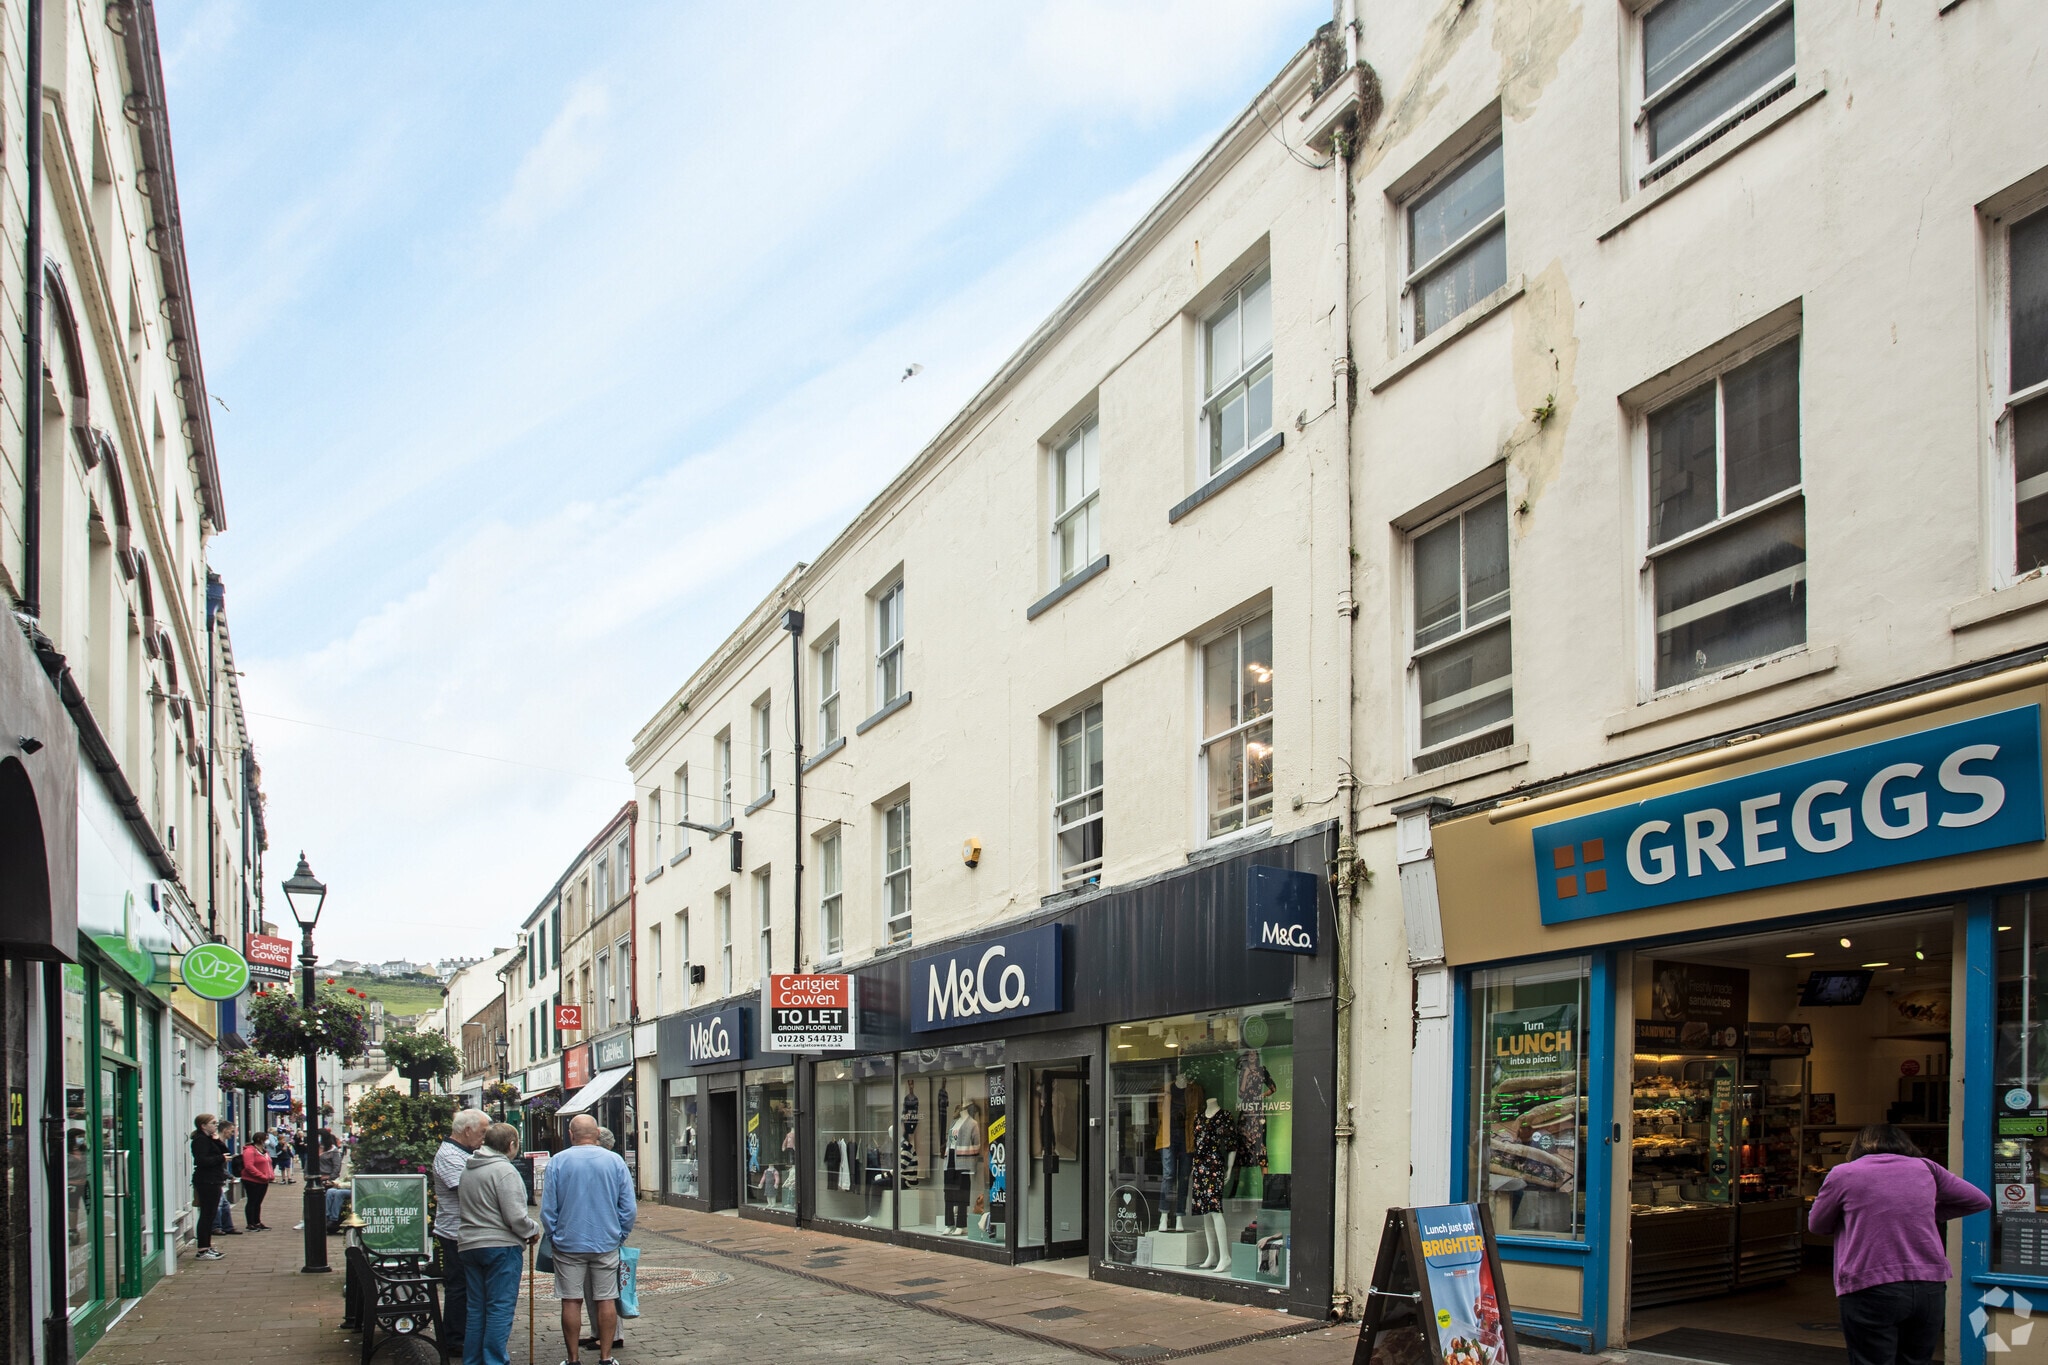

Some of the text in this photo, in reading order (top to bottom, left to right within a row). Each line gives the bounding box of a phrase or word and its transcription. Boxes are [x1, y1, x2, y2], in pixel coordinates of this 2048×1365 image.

[1626, 743, 2006, 885] GREGGS
[1262, 921, 1312, 949] M&Co.
[251, 939, 290, 954] Carigiet
[251, 949, 288, 963] Cowen
[190, 952, 243, 983] VPZ
[249, 965, 269, 973] 01228
[270, 966, 290, 976] 544733
[780, 977, 840, 994] Carigiet
[928, 945, 1030, 1022] M&Co.
[780, 991, 835, 1005] Cowen
[1688, 995, 1731, 1008] sandwiches
[777, 1009, 842, 1024] TO LET
[1523, 1021, 1544, 1031] Turn
[1641, 1025, 1676, 1039] SANDWICH
[690, 1016, 730, 1060] M&Co.
[1497, 1030, 1572, 1057] LUNCH
[1510, 1057, 1525, 1066] into
[1532, 1055, 1557, 1066] picnic
[991, 1075, 1002, 1086] BLUE
[11, 1092, 23, 1127] 23
[1236, 1101, 1291, 1112] MUST HAVES
[990, 1142, 1005, 1164] 20
[992, 1163, 1006, 1177] OFF
[383, 1181, 399, 1189] VPZ
[992, 1191, 1006, 1203] SALE
[362, 1207, 419, 1216] ARE YOU READY
[1117, 1207, 1137, 1219] Love
[362, 1216, 410, 1225] TO MAKE THE
[1111, 1219, 1144, 1235] LOCAL
[362, 1225, 395, 1233] SWITCH?
[1424, 1221, 1475, 1235] Lunch just got
[1422, 1235, 1485, 1258] BRIGHTER
